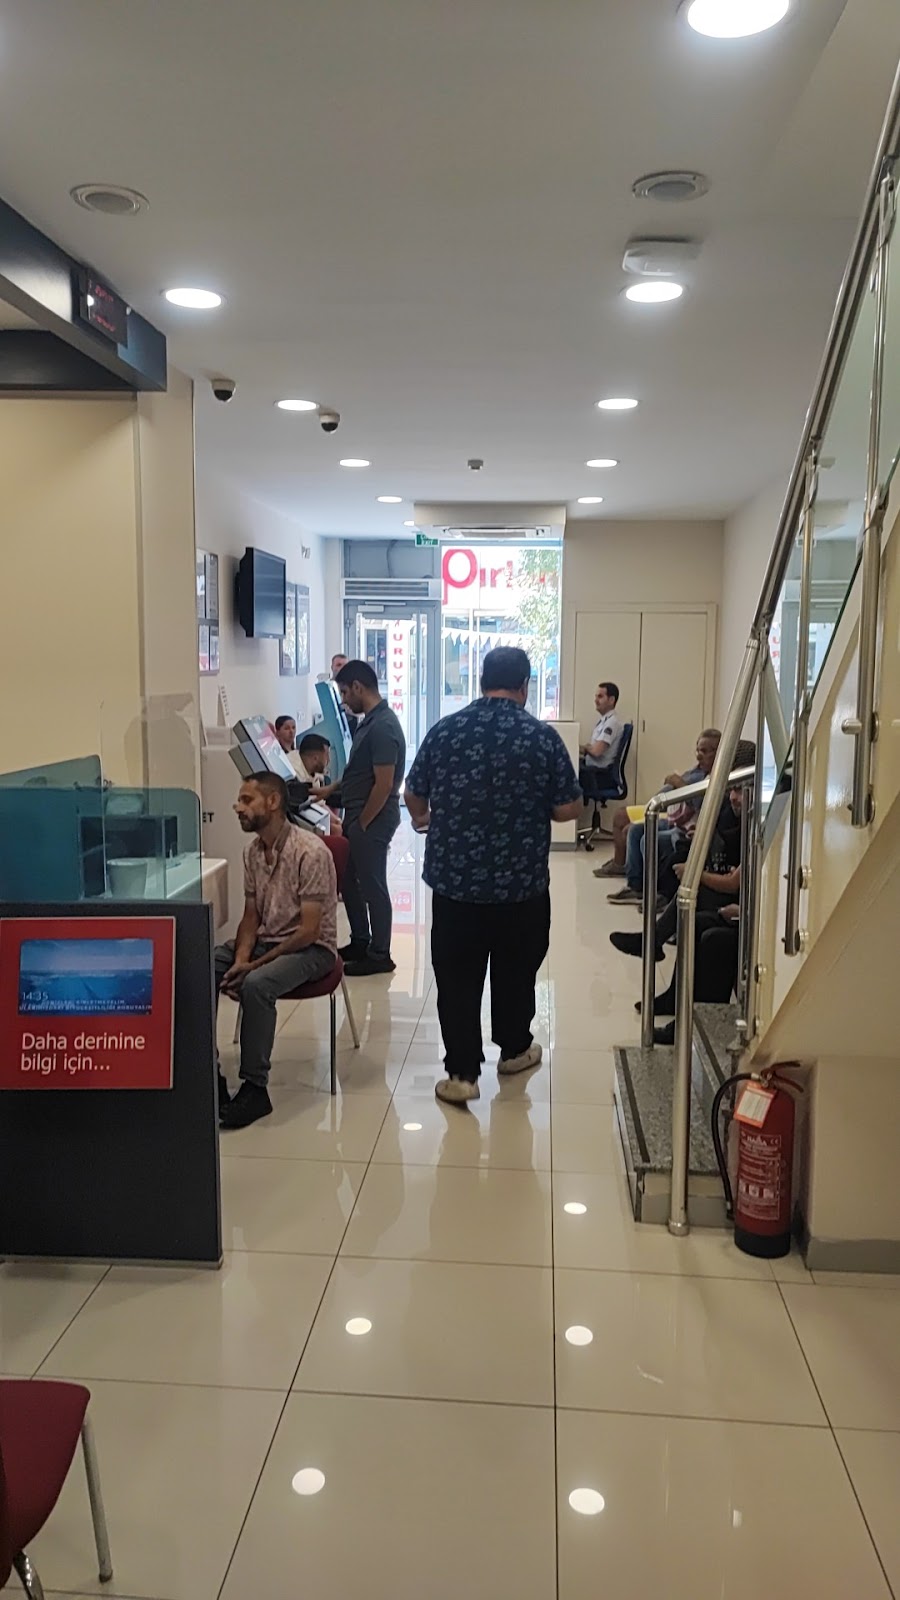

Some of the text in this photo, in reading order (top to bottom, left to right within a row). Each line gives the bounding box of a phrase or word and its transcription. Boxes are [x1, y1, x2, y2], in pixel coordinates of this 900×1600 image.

[22, 1032, 146, 1050] Daha derinine
[20, 1052, 111, 1075] bilgi için...
